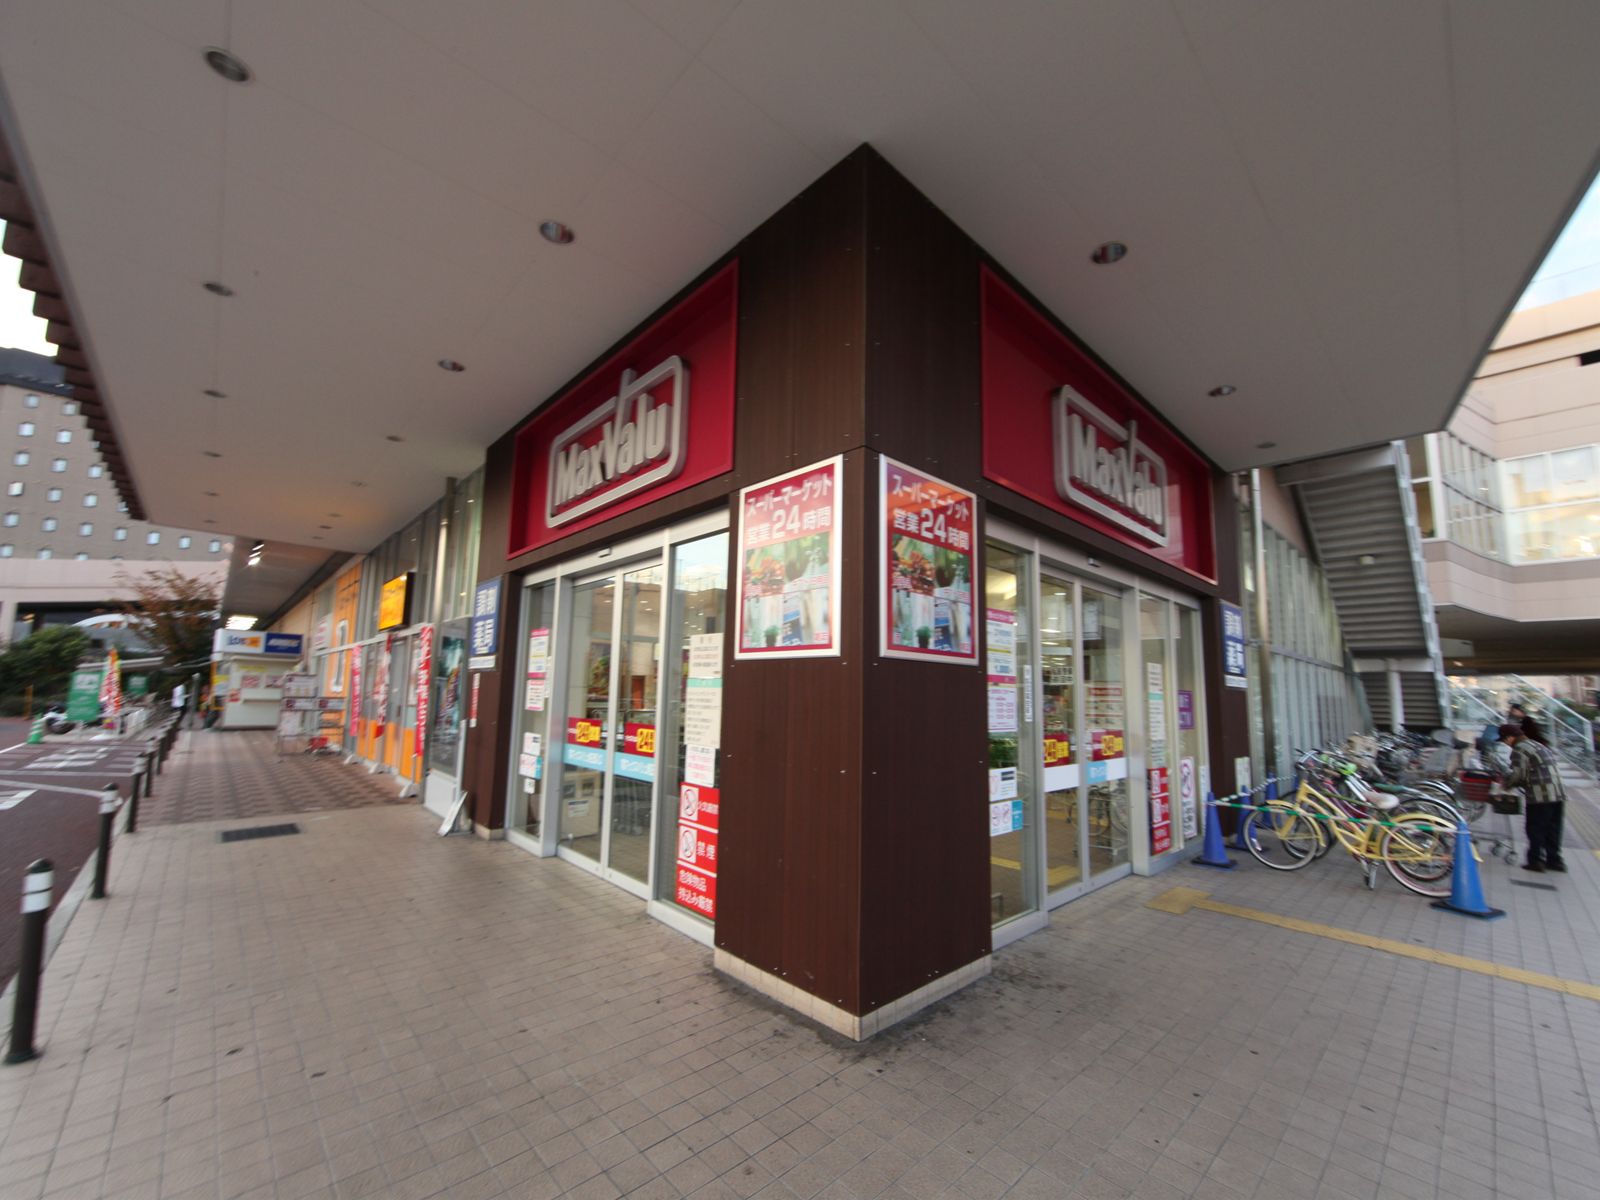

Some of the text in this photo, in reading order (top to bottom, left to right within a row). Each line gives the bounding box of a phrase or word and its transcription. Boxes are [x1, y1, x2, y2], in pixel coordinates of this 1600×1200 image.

[554, 368, 669, 507] MaxValu
[1069, 413, 1163, 526] MaxValu
[747, 472, 833, 517] スーパーマーケット
[892, 474, 970, 522] スーパーマーケット
